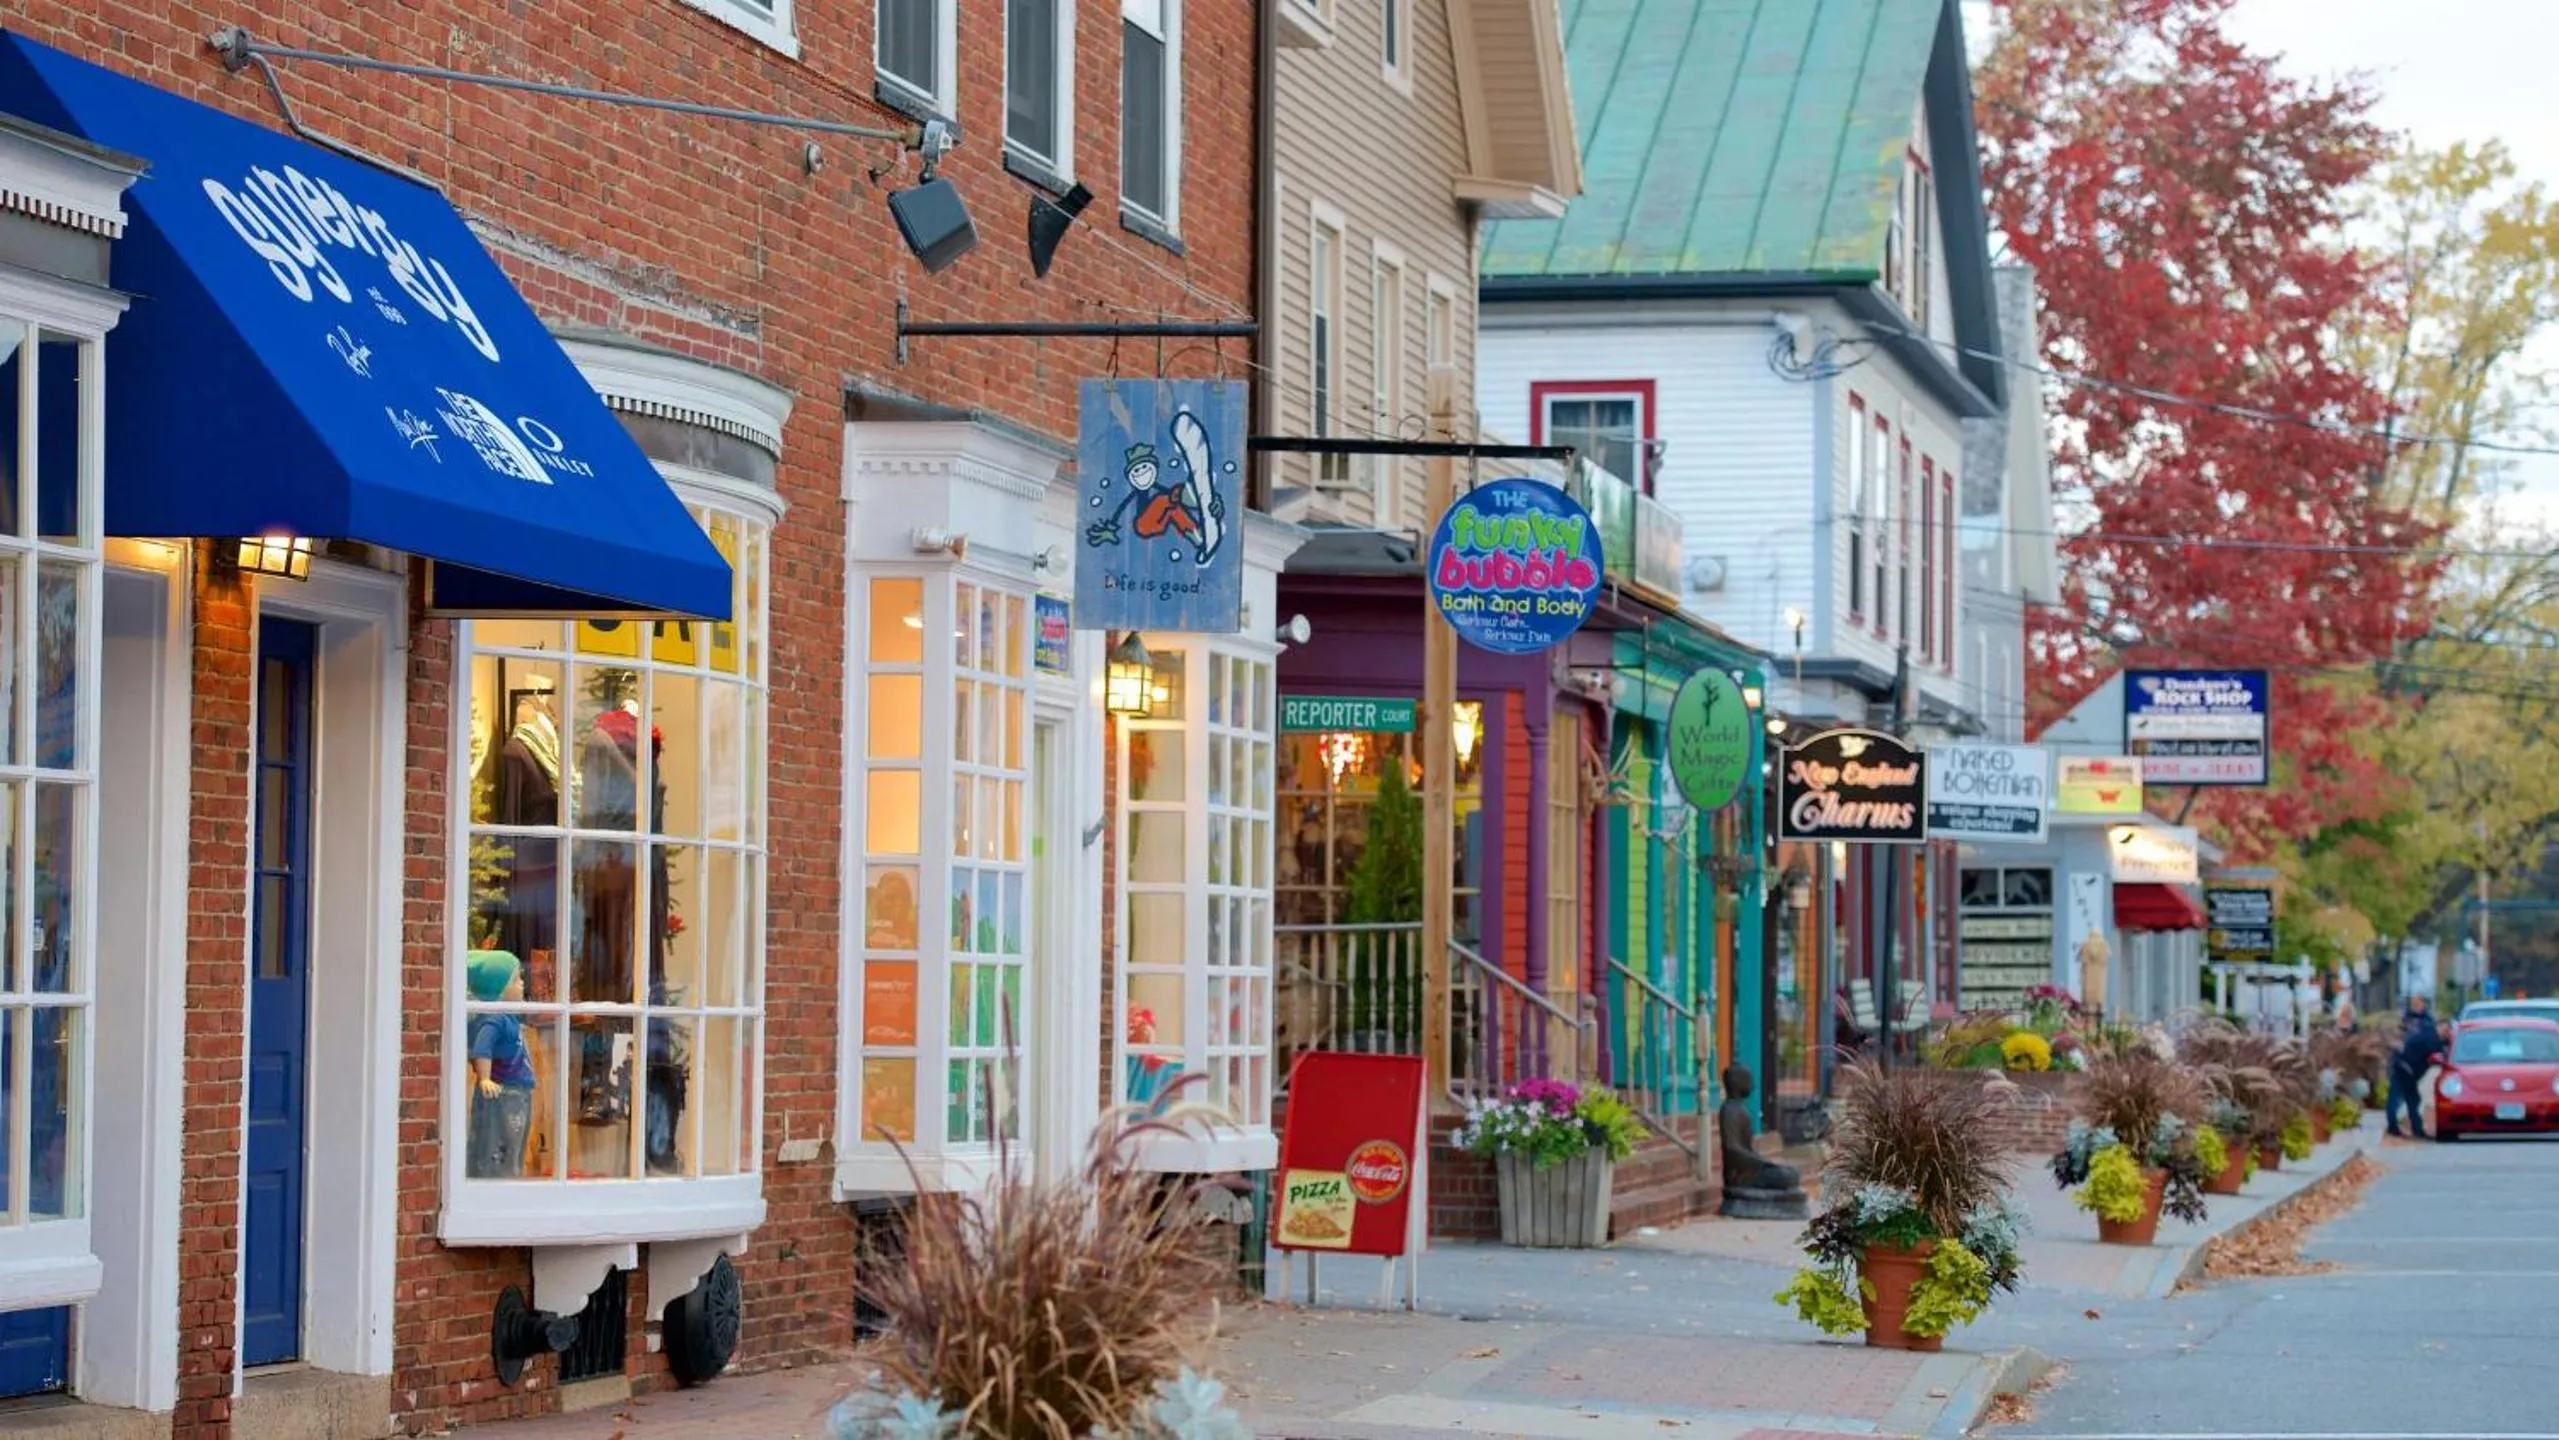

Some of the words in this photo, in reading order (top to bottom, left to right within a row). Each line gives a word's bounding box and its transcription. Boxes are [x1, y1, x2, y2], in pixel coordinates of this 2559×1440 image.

[436, 387, 478, 424] THE
[436, 408, 504, 451] NORTH
[473, 443, 524, 481] FACE
[1492, 490, 1529, 508] THE
[1450, 504, 1587, 561] funky
[1436, 543, 1598, 592] bubble
[1105, 573, 1136, 591] Life
[1140, 578, 1156, 591] is
[1442, 593, 1484, 613] Bath
[1488, 594, 1530, 613] and
[1537, 596, 1586, 618] Body
[2153, 690, 2200, 705] ROCK
[2205, 690, 2252, 706] SHOP
[1286, 701, 1377, 727] REPORTER
[1381, 709, 1410, 722] COURT
[1680, 726, 1740, 744] World
[1951, 749, 2014, 772] NAKED
[1788, 760, 1840, 790] New
[1841, 760, 1919, 789] England
[1944, 770, 2043, 798] BOHEMIAN
[1790, 791, 1916, 832] Charms
[1290, 1181, 1341, 1204] PIZZA
